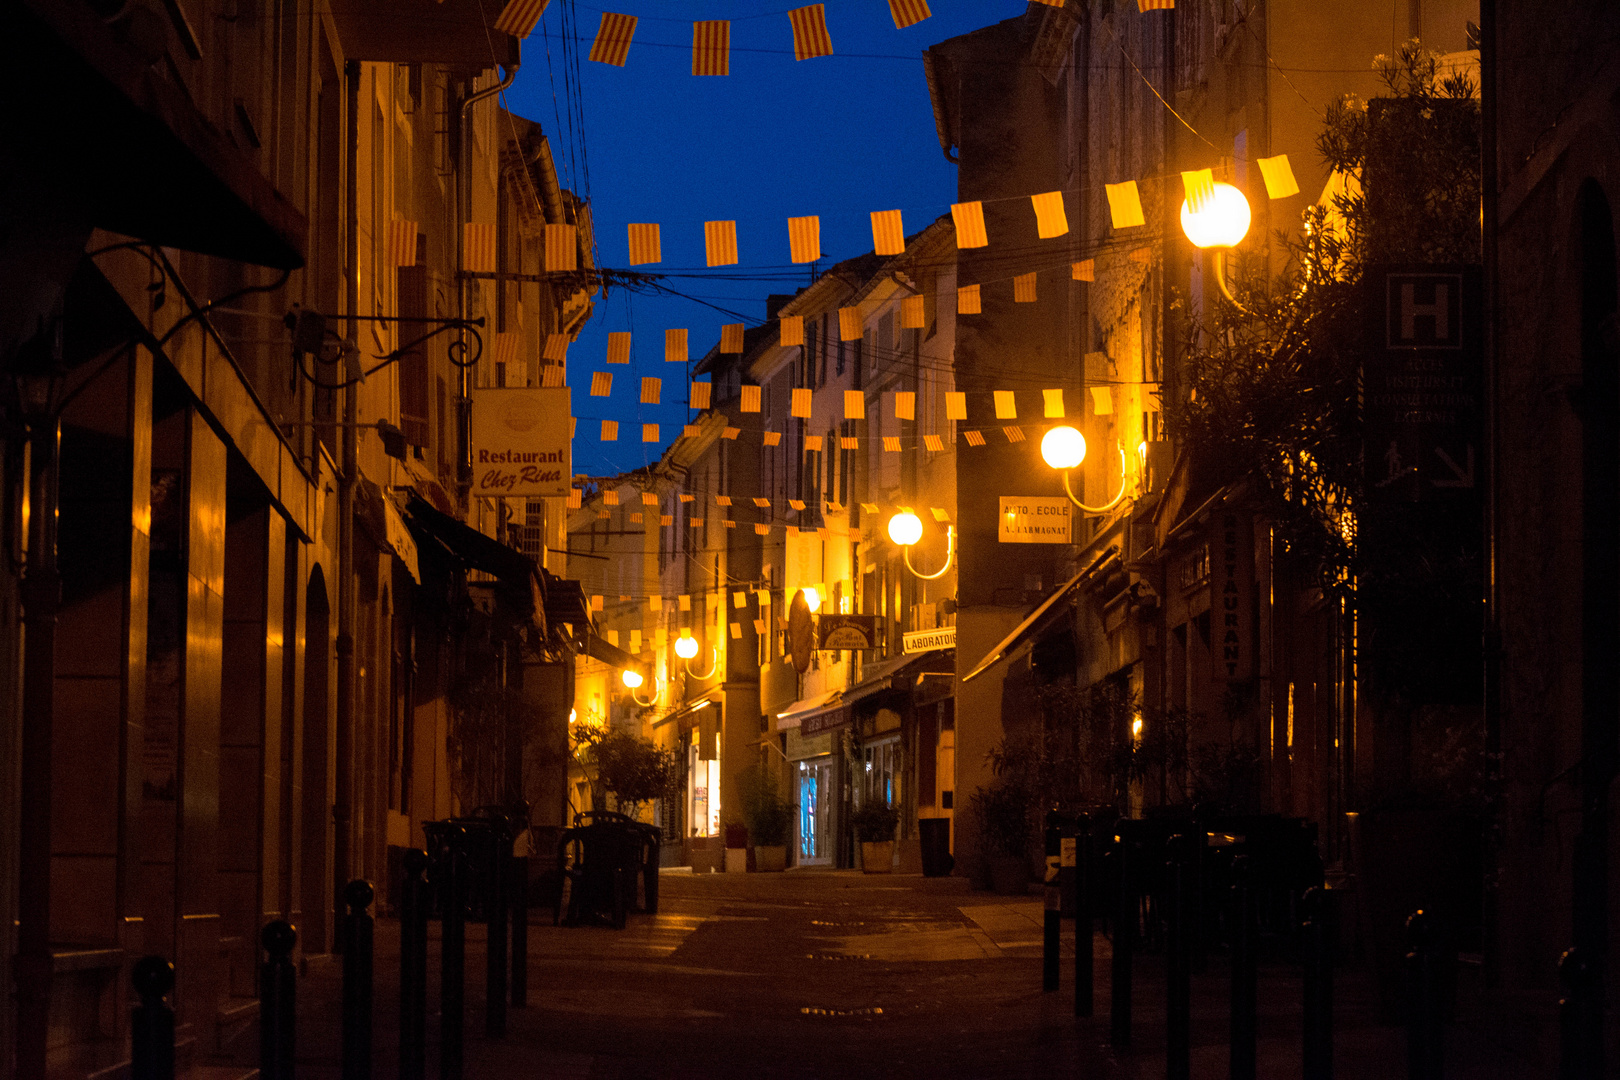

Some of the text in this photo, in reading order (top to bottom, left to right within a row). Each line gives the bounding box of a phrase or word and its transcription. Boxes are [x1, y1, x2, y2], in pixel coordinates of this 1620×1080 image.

[1400, 283, 1449, 339] H
[1384, 375, 1448, 388] VISITEURS
[1373, 392, 1475, 406] CONSULTATIONS
[1393, 410, 1457, 423] EXTERNES
[479, 449, 564, 463] Restaurant
[480, 465, 562, 491] Chez Rina
[1037, 506, 1069, 516] ECOLE
[1223, 514, 1239, 676] RESTAURANT
